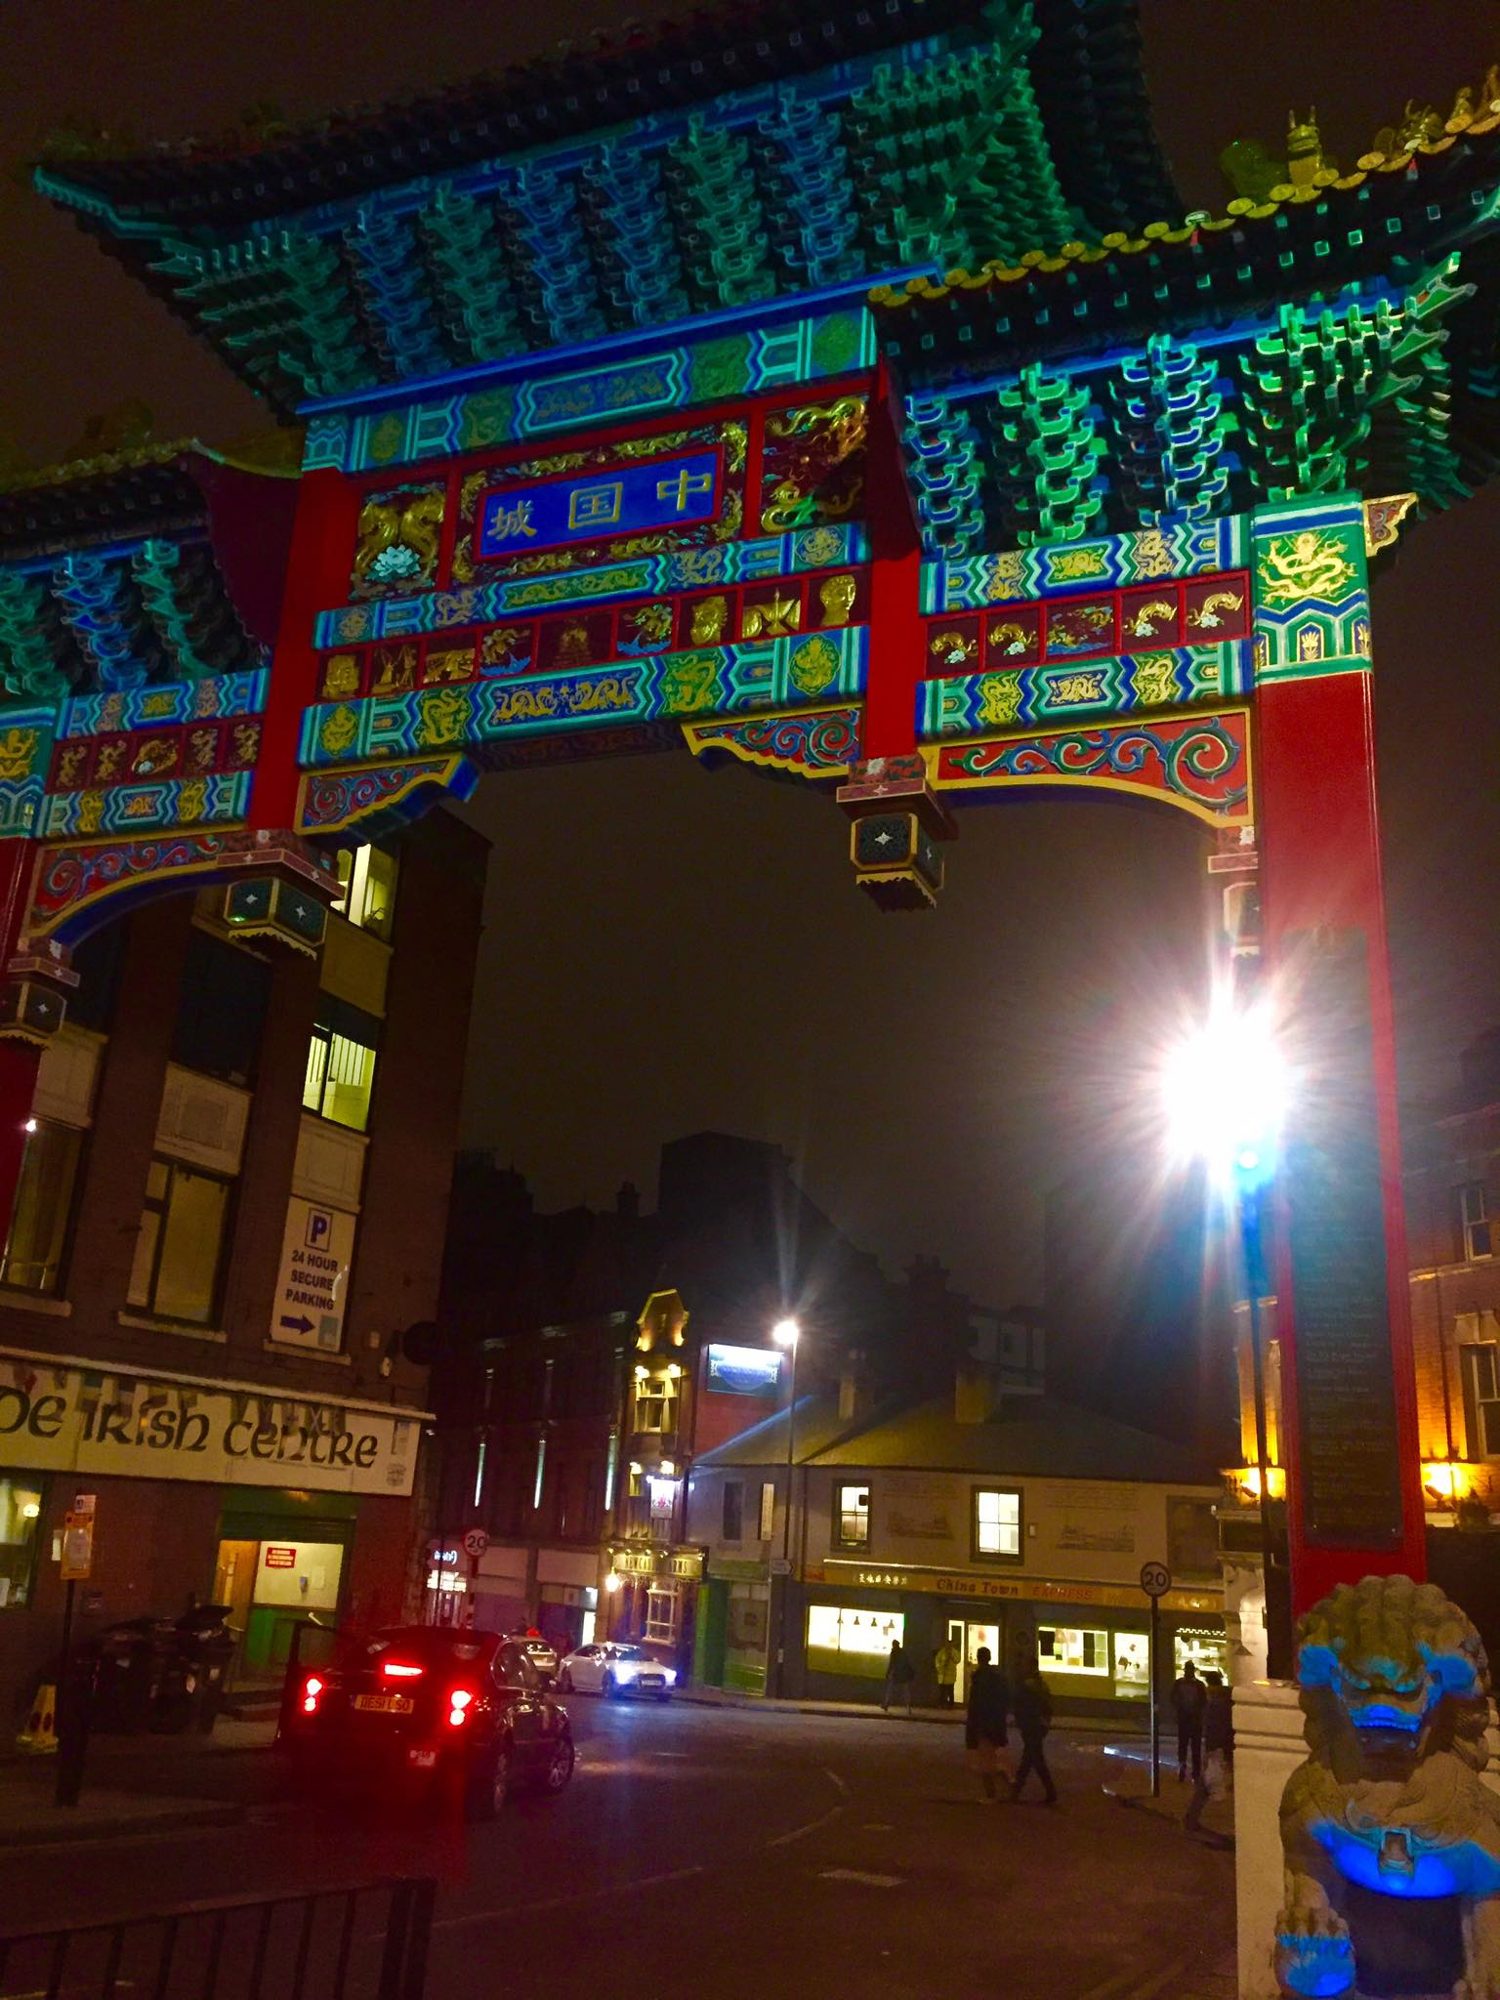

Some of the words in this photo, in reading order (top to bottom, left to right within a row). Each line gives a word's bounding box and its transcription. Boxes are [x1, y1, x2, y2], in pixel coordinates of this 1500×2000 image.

[310, 1214, 328, 1244] P
[291, 1249, 305, 1264] 24
[306, 1253, 339, 1272] HOUR
[290, 1269, 334, 1291] SECURE
[285, 1288, 335, 1311] PARKING
[467, 1535, 486, 1549] 20
[936, 1578, 976, 1593] China
[982, 1581, 1019, 1596] Town
[1144, 1571, 1167, 1587] 20
